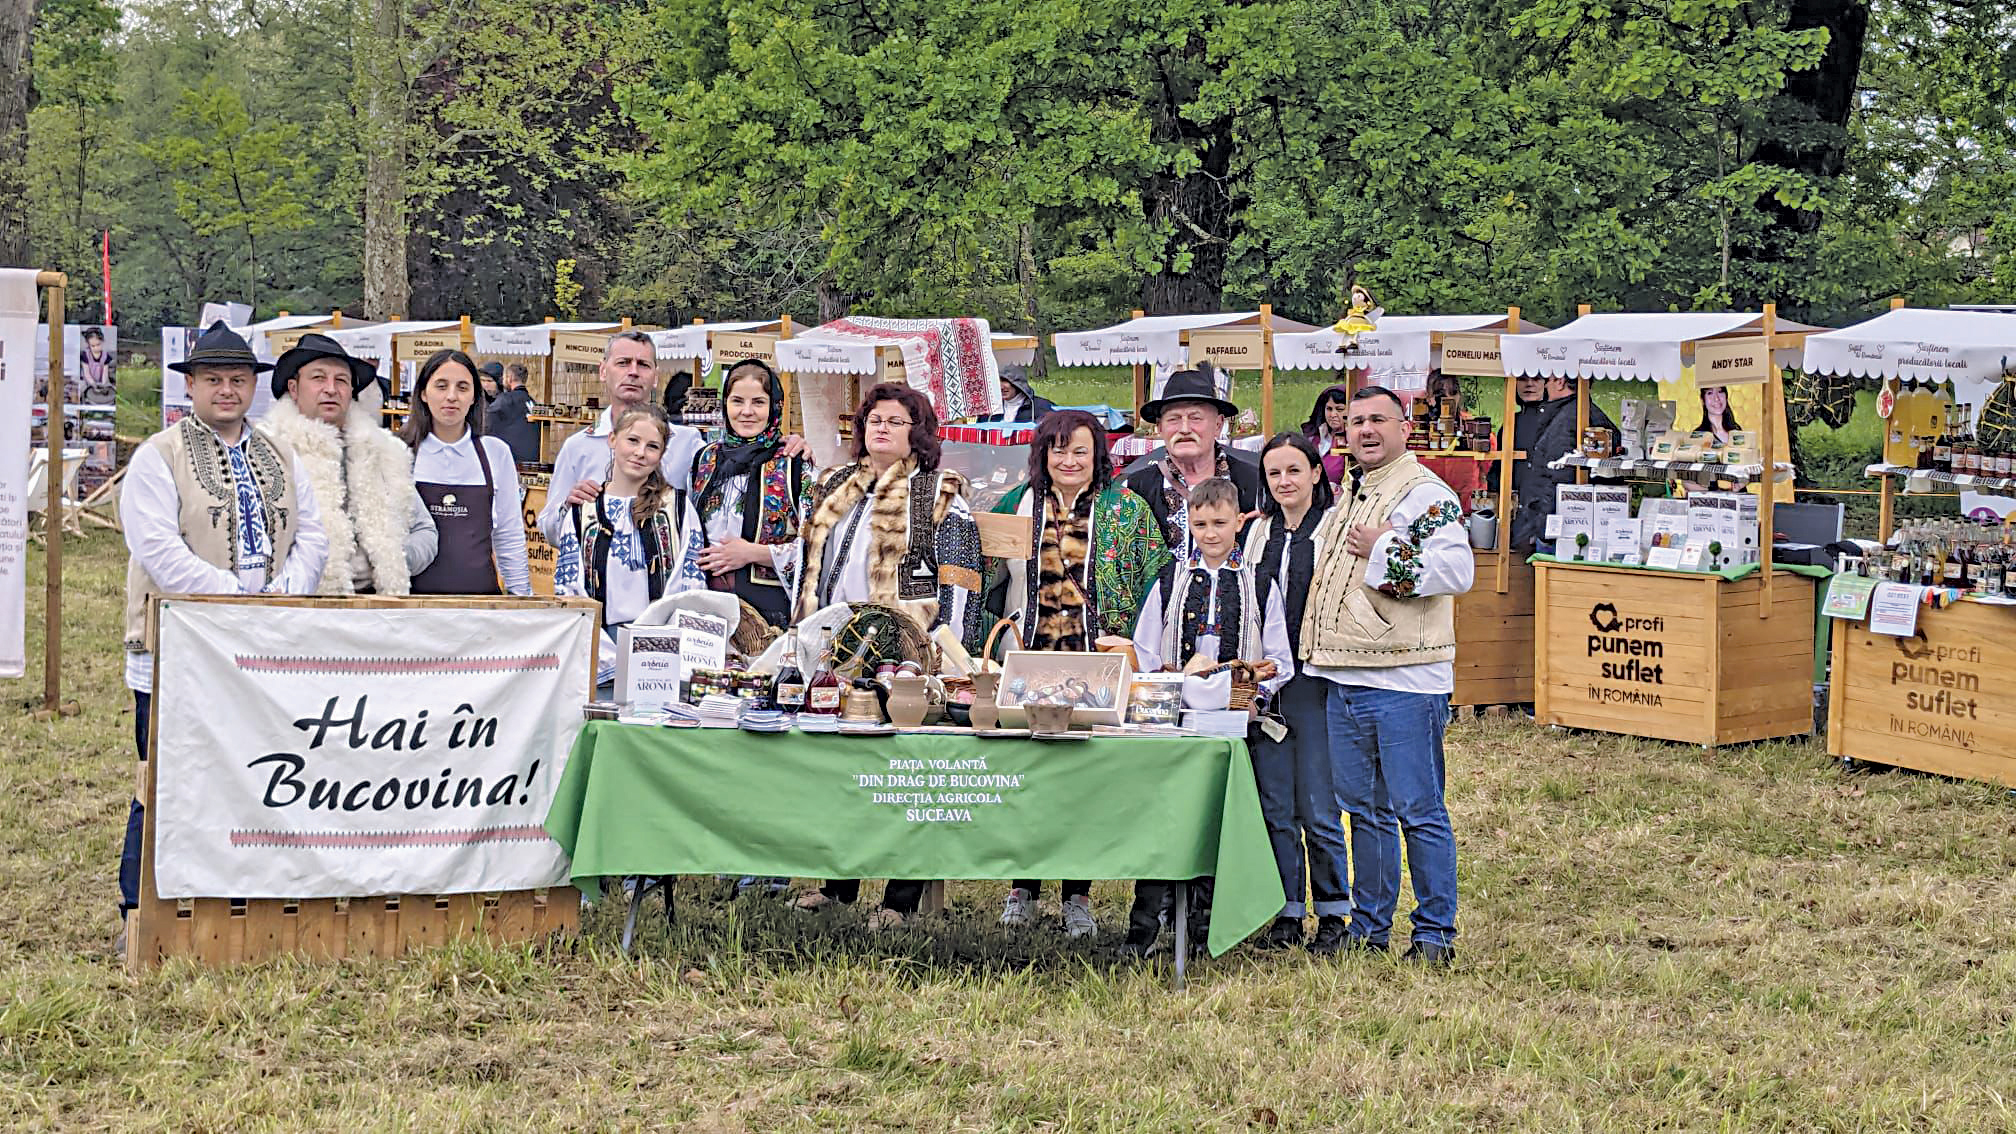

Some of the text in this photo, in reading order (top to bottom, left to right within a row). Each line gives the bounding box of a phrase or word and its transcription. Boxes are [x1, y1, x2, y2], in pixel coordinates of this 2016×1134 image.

[719, 349, 773, 361] PRODCONSERV
[1205, 346, 1248, 355] RAFFAELLO
[1446, 349, 1482, 360] CORNELIU
[1711, 356, 1753, 370] ANDY STAR
[1625, 616, 1664, 632] profi
[1588, 635, 1663, 658] punem
[1936, 645, 1981, 663] profi
[681, 654, 718, 668] ARONIA
[1601, 659, 1663, 684] suflet
[1891, 661, 1980, 693] punem
[637, 681, 673, 691] ARONIA
[1588, 683, 1663, 708] ÎN ROMÂNIA
[1906, 689, 1977, 720] suflet
[293, 694, 498, 751] Hai în
[1889, 713, 1976, 745] ÎN ROMÂNIA
[928, 756, 988, 770] VOLANTĂ
[246, 752, 541, 812] Bucovina!
[888, 774, 925, 788] DRAG
[928, 774, 947, 788] DE
[950, 774, 1025, 788] BUCOVINA"
[936, 792, 1002, 804] AGRICOLA
[906, 808, 972, 822] SUCEAVA
